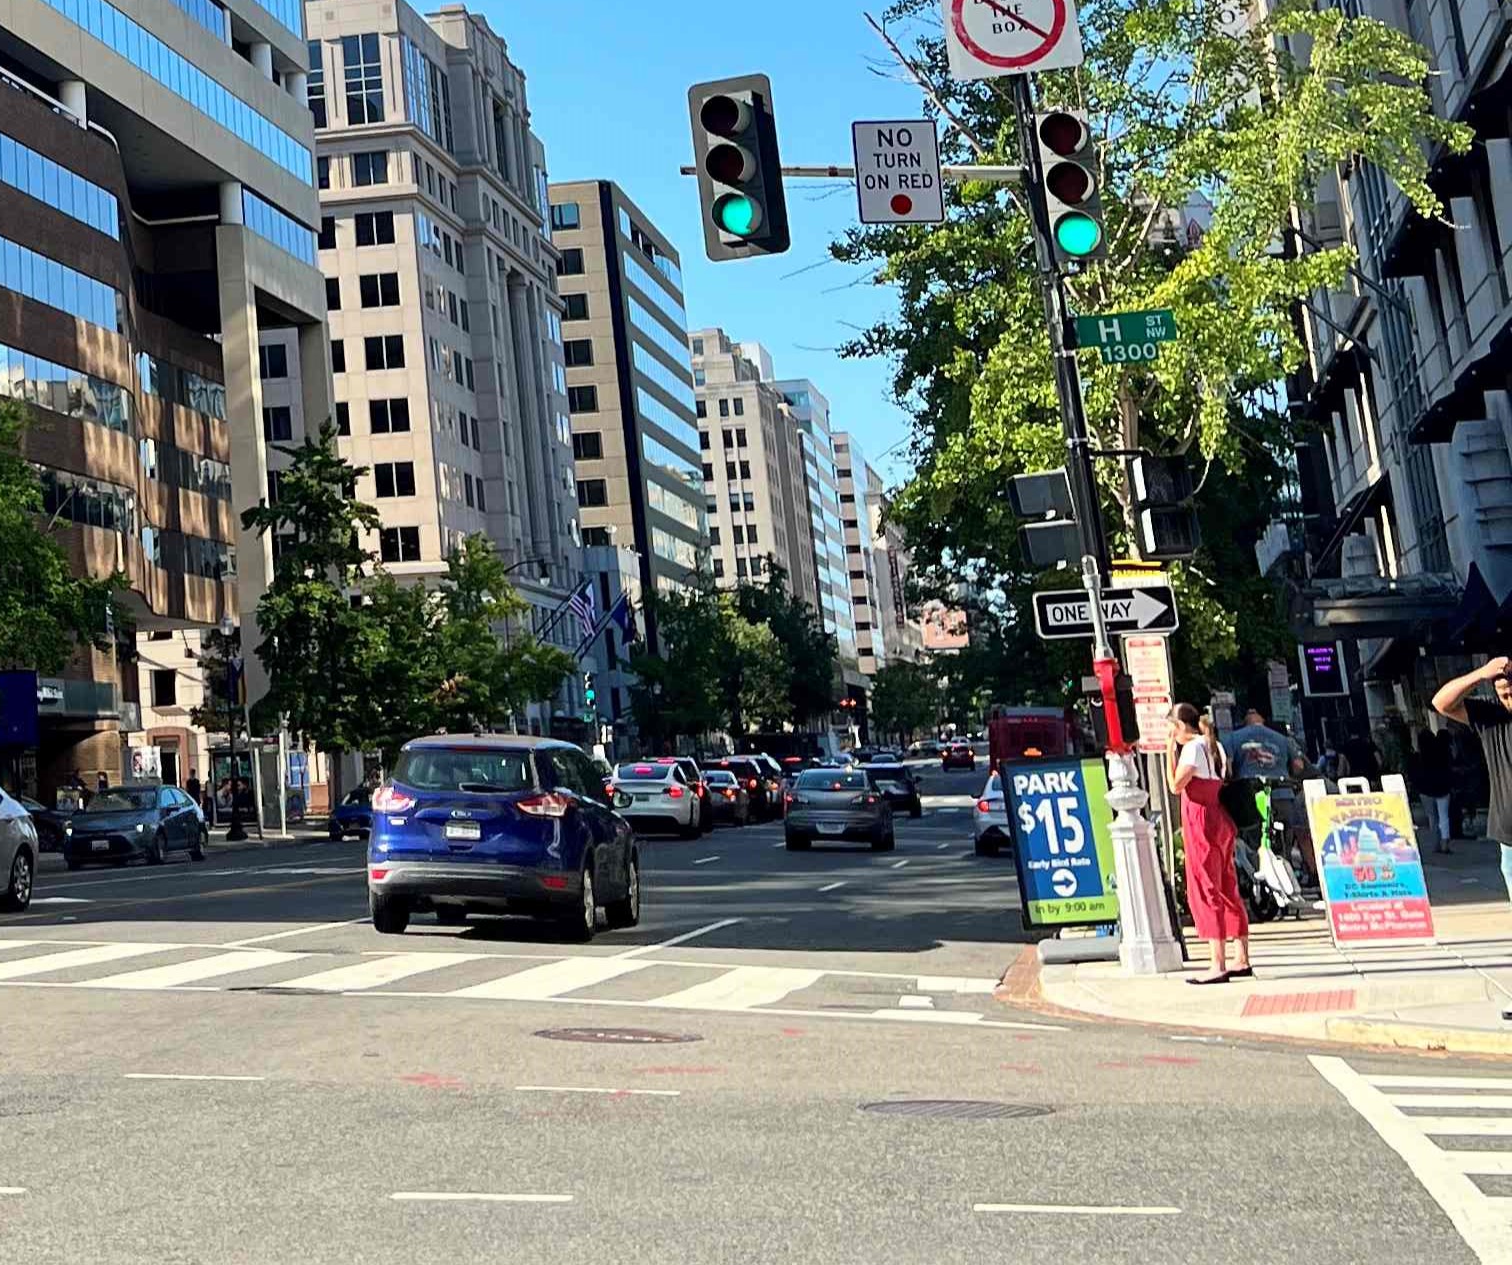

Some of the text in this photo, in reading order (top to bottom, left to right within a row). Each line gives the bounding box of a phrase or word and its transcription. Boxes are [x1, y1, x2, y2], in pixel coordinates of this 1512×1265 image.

[992, 21, 1029, 34] BOX
[877, 128, 913, 148] NO
[873, 153, 921, 168] TURN
[865, 173, 933, 190] ON RED
[1098, 315, 1163, 343] H ST
[1146, 326, 1167, 338] NW
[1103, 342, 1157, 362] 1300
[1052, 604, 1090, 622] ONE
[1013, 770, 1079, 796] PARK
[1018, 796, 1085, 855] $15
[1028, 859, 1050, 871] Early
[1035, 901, 1106, 916] In by 9:00 am
